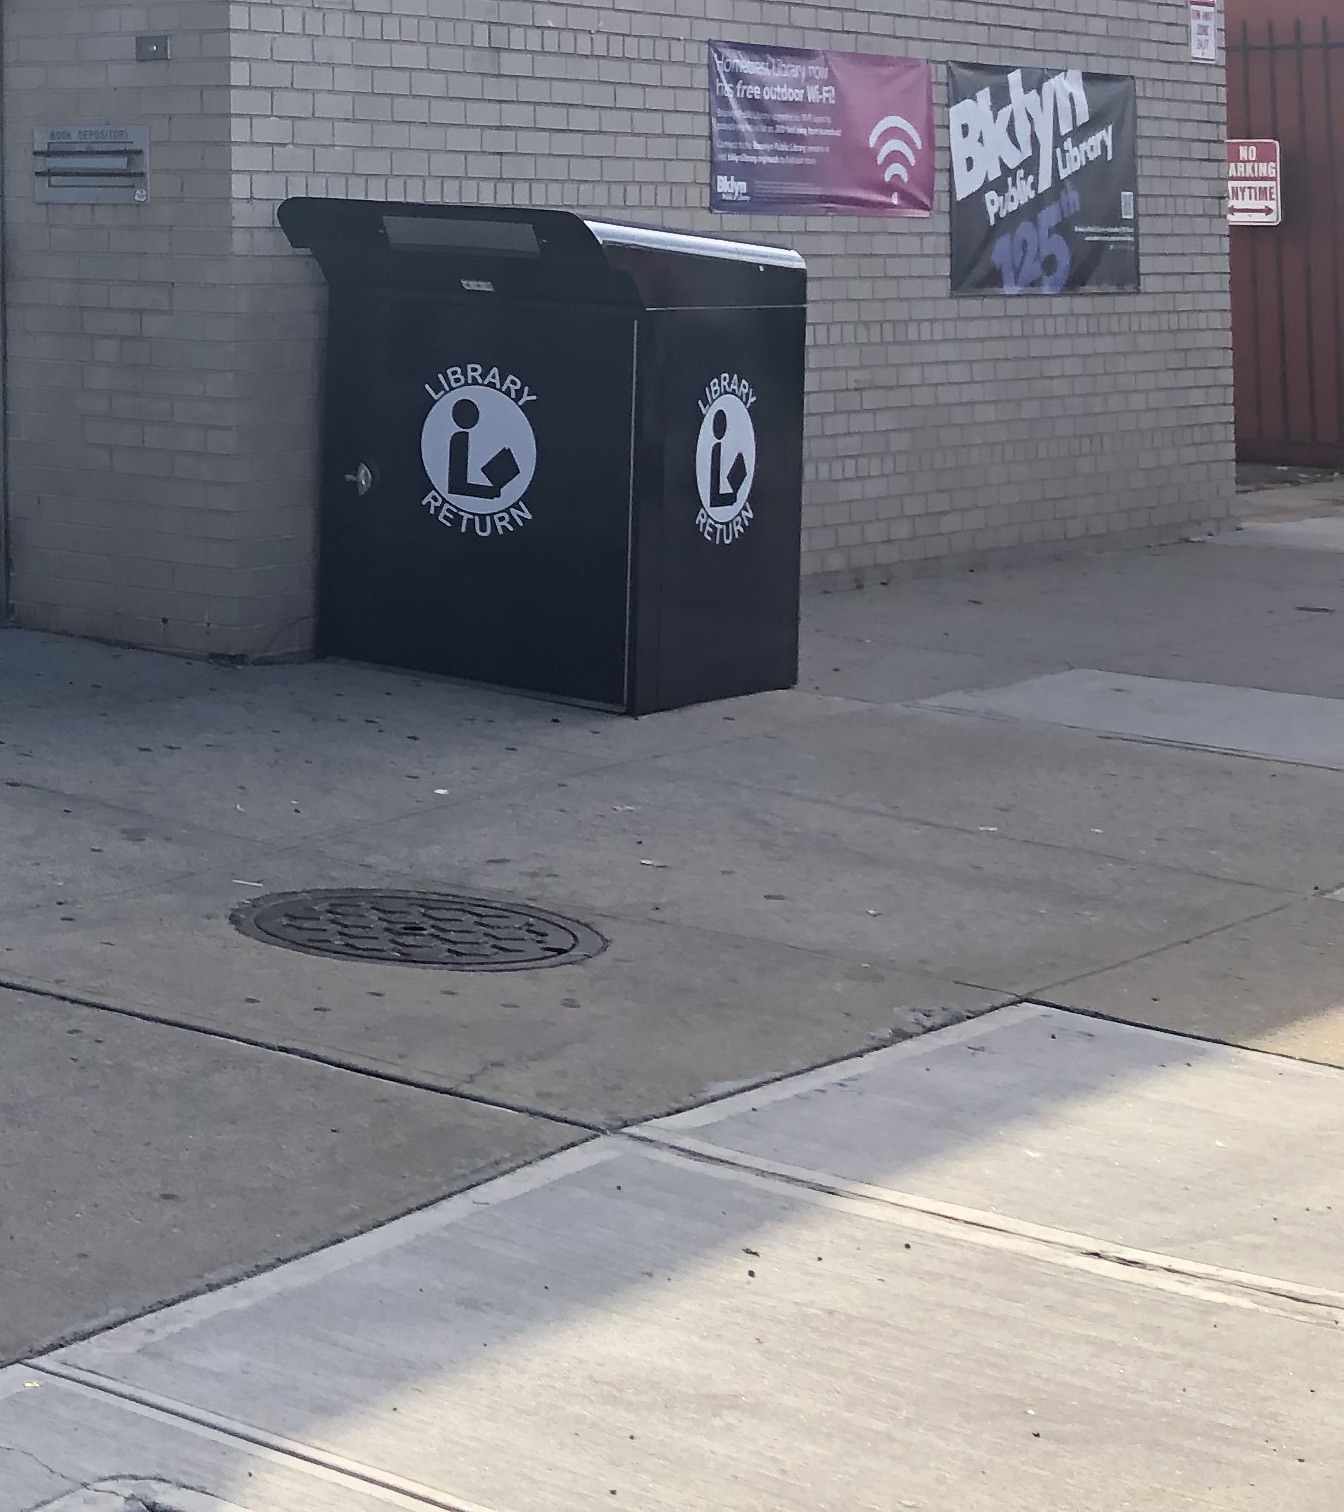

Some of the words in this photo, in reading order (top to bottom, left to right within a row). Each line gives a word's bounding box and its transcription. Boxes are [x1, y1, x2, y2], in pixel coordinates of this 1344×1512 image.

[736, 80, 761, 99] free
[763, 83, 805, 102] outdoor
[950, 68, 1090, 201] Bklyn
[1055, 124, 1113, 180] Library
[1239, 145, 1257, 161] NO
[1228, 161, 1276, 177] ARKING
[984, 169, 1036, 226] Public
[424, 364, 538, 407] LIBRARY
[697, 371, 757, 414] LIBRARY
[421, 491, 534, 538] RETURN
[695, 505, 755, 546] RETURN
